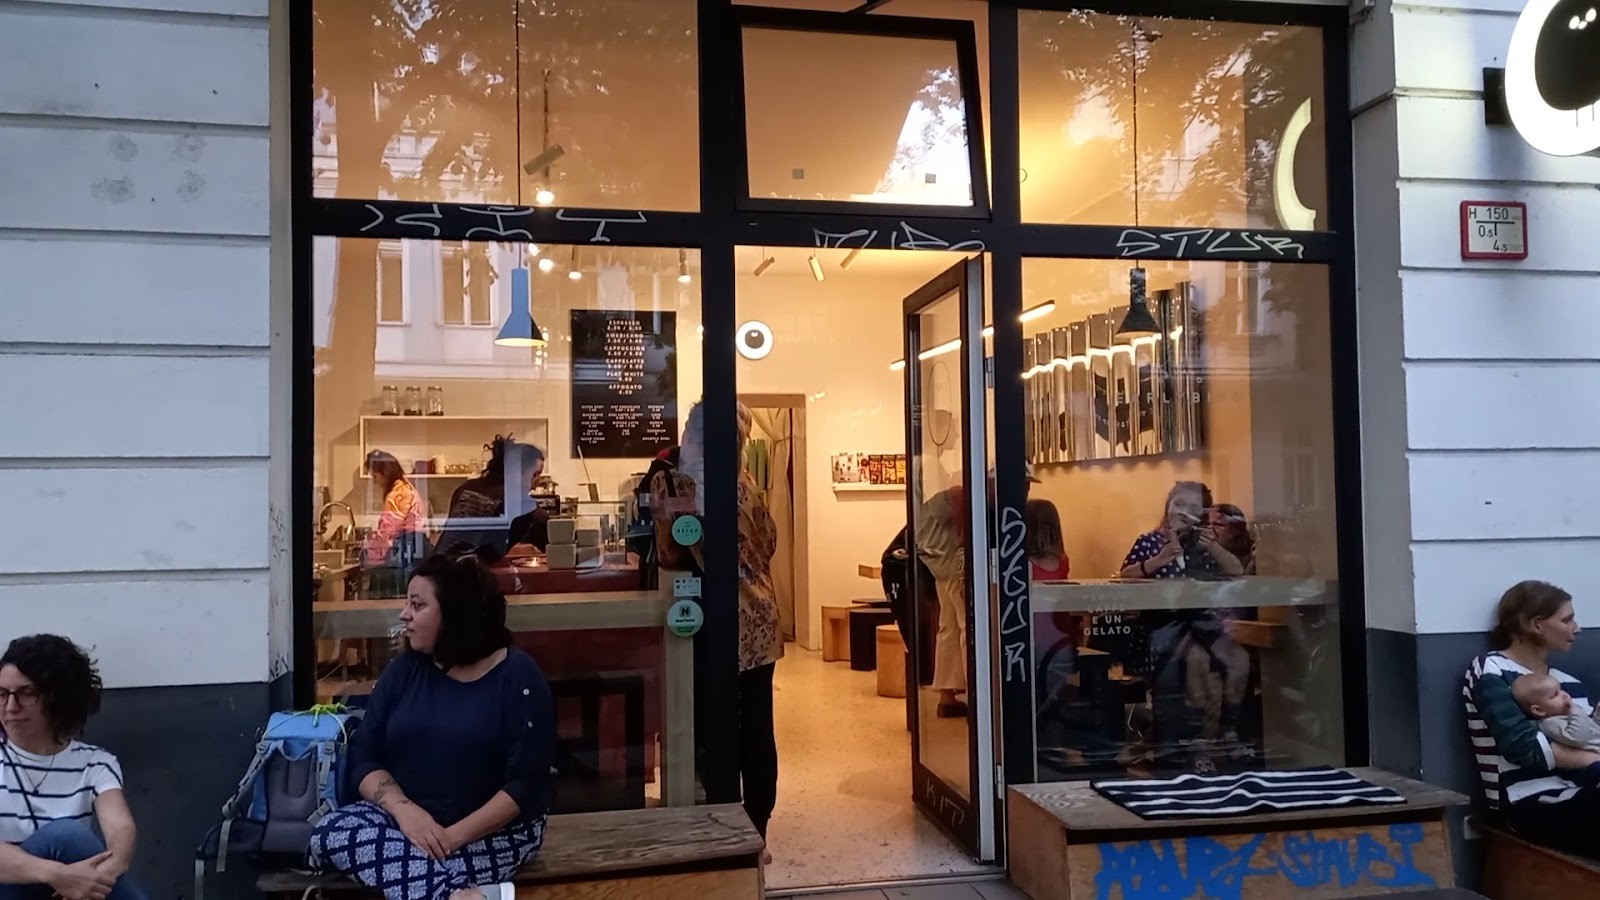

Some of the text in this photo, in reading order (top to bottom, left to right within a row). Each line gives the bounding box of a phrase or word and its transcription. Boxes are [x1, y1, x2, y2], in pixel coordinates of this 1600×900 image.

[1468, 207, 1509, 220] H 150
[1493, 239, 1508, 252] 4.5
[1092, 615, 1122, 625] E UN
[1083, 626, 1131, 636] GELATO
